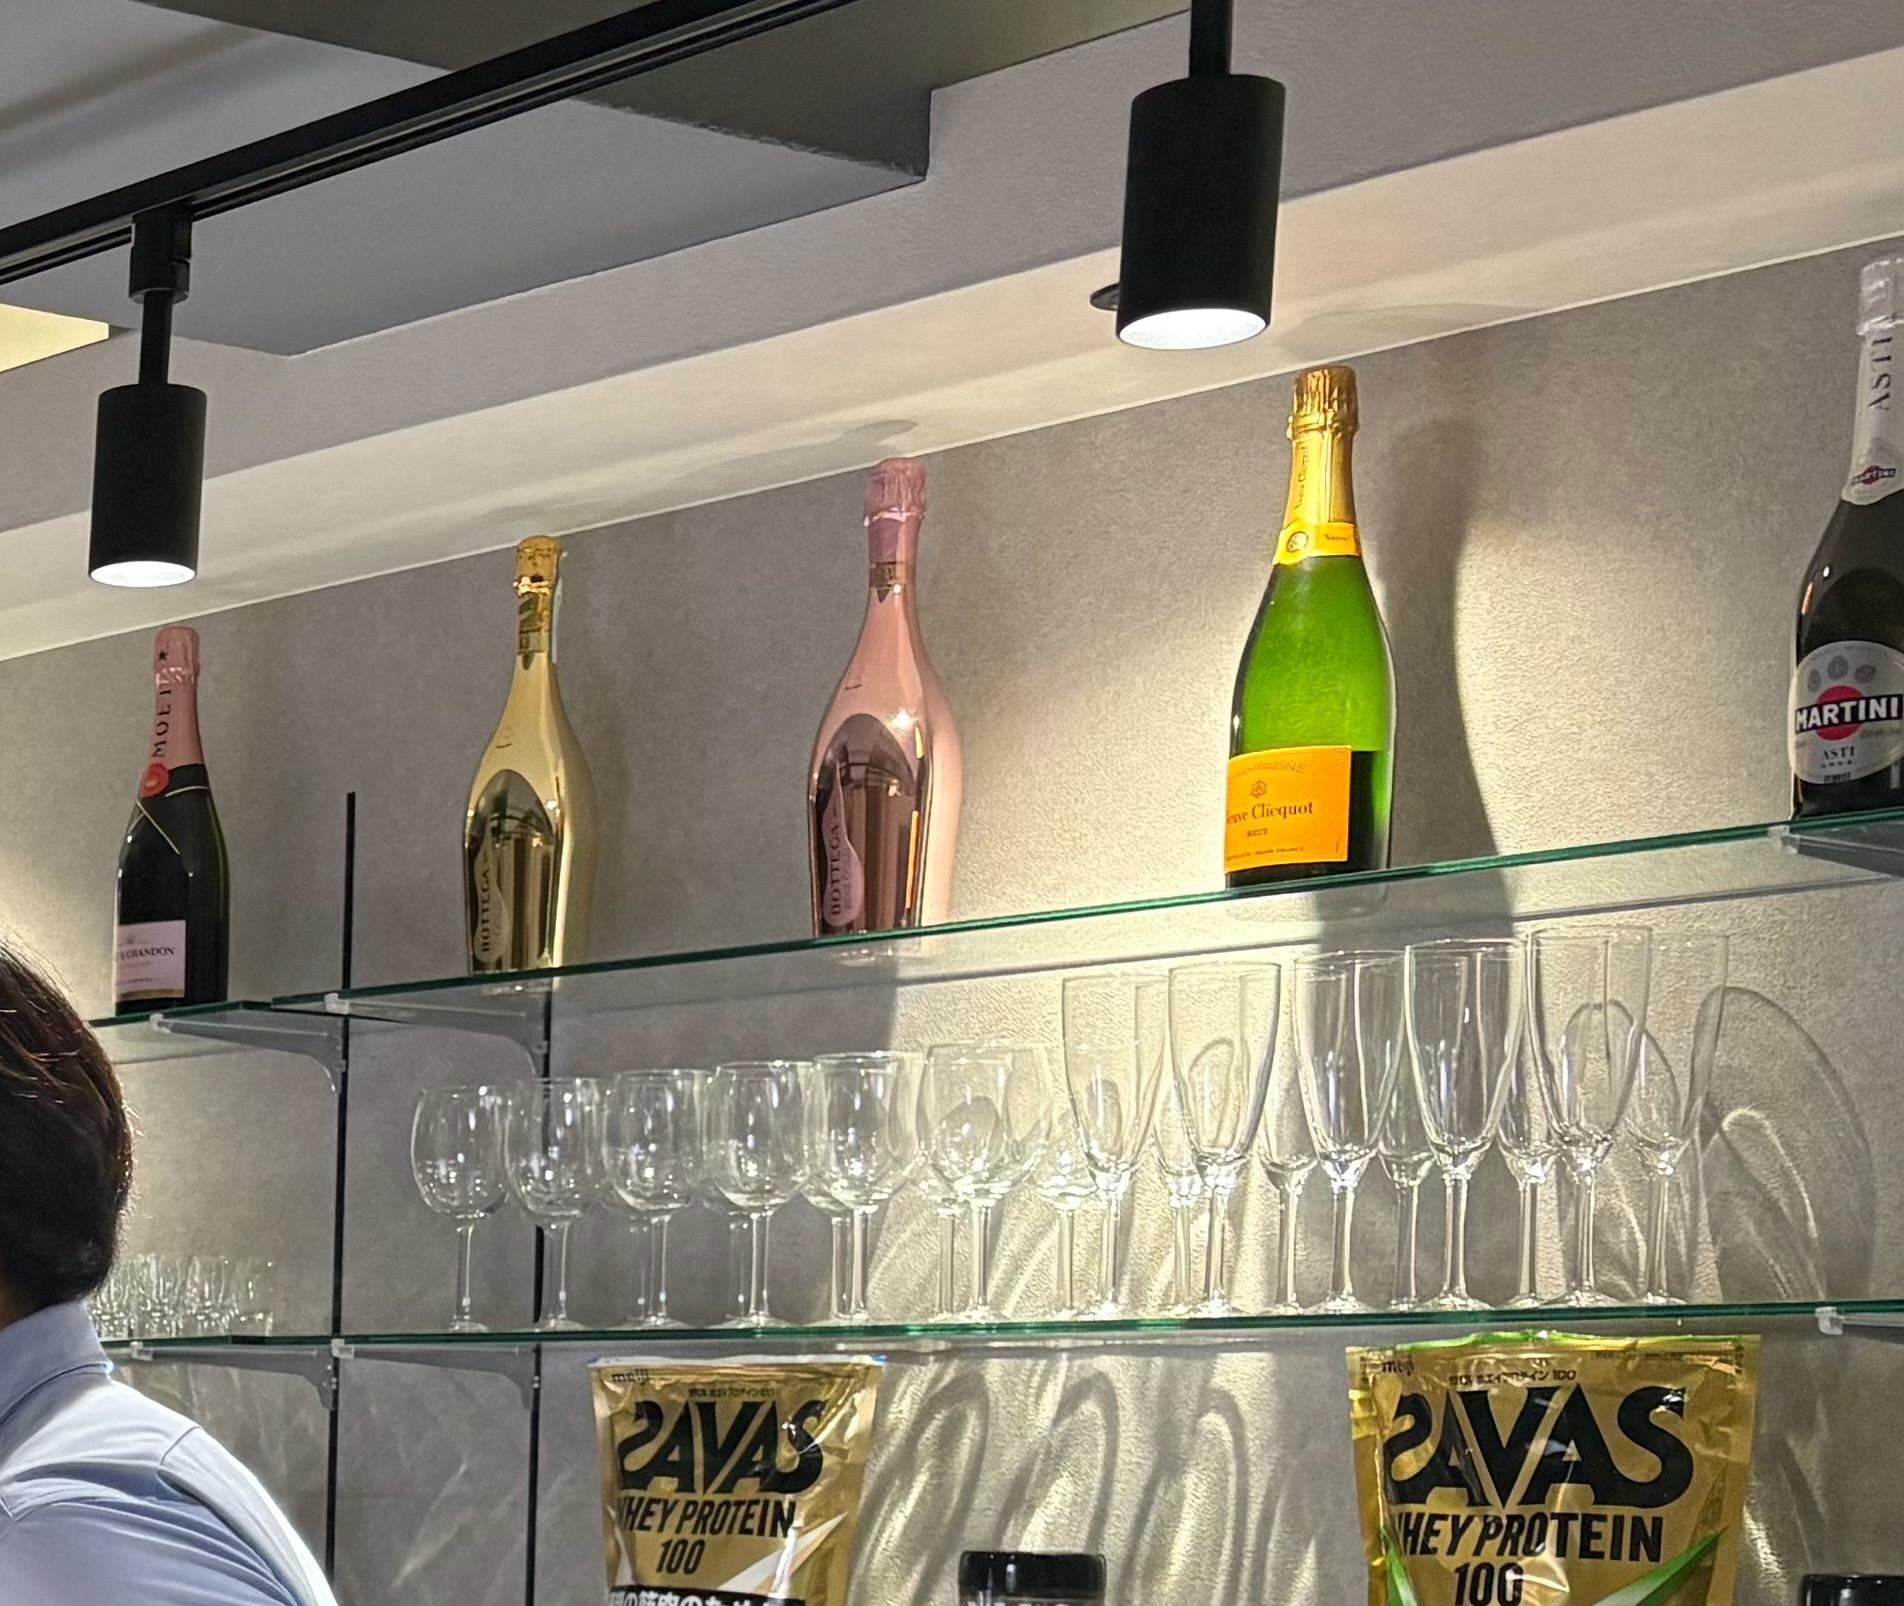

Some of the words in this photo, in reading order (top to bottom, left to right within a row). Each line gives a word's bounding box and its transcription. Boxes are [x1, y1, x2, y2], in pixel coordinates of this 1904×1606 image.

[1867, 337, 1893, 410] ASTI
[1796, 697, 1899, 732] MARTINI
[1823, 746, 1855, 760] ASTI
[1252, 802, 1313, 819] Clicquot
[831, 824, 841, 916] BOTTEGA
[618, 1399, 826, 1495] SAVAS
[1383, 1383, 1694, 1510] SAVAS
[675, 1498, 796, 1538] PROTEIN
[1473, 1512, 1664, 1563] PROTEIN
[656, 1539, 705, 1575] 100
